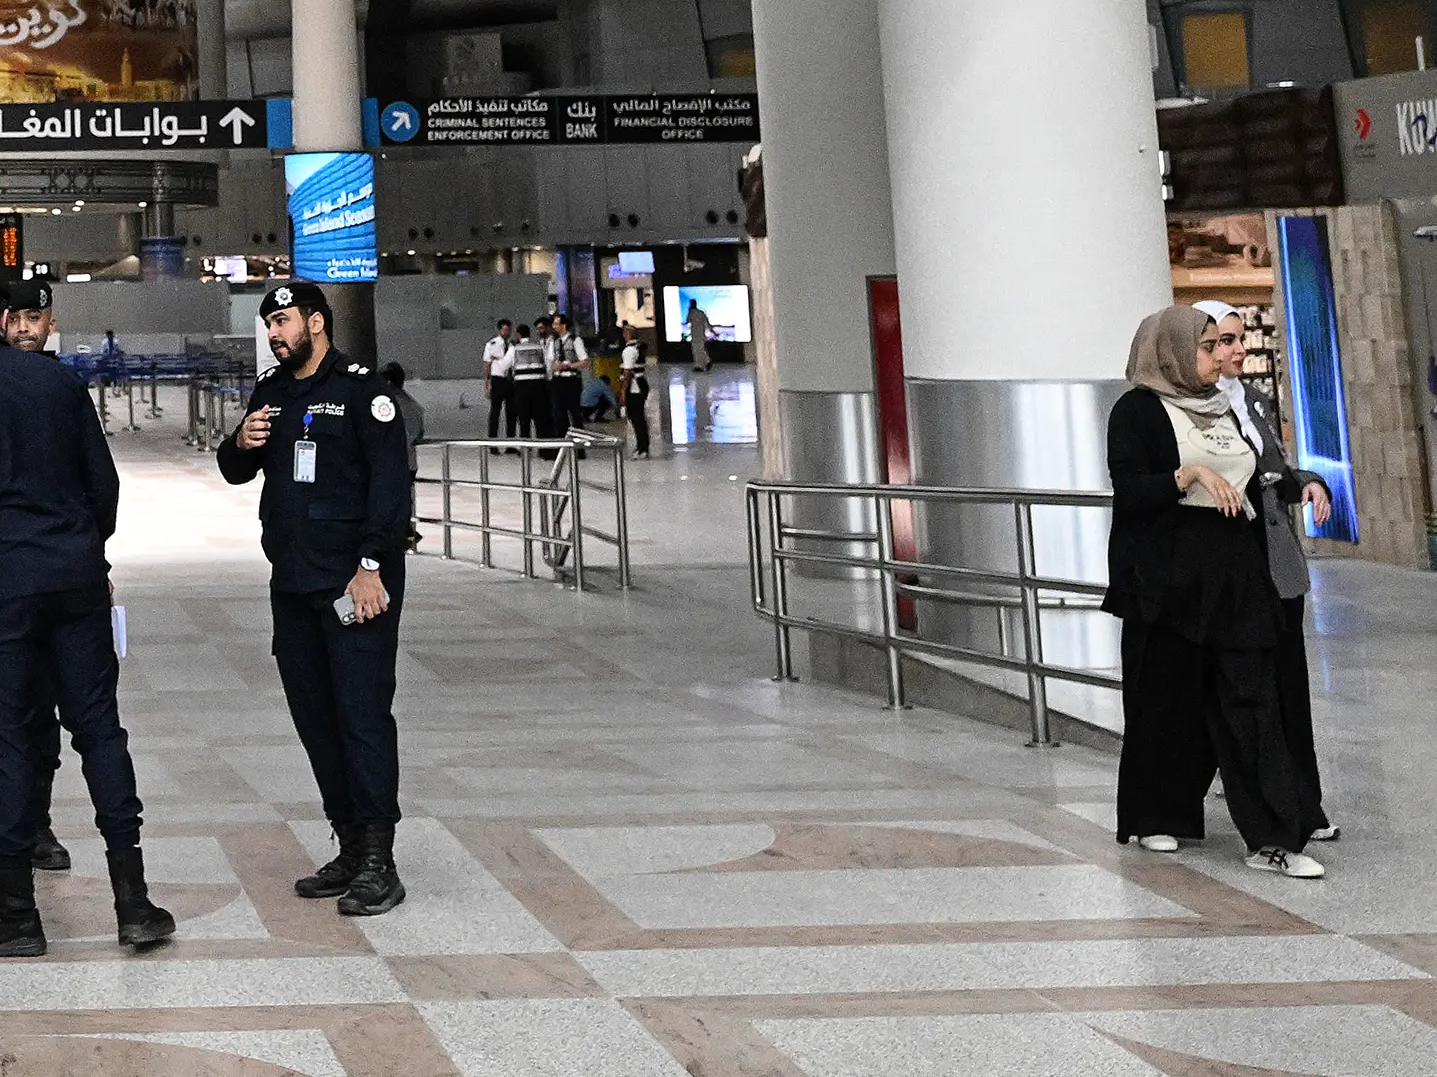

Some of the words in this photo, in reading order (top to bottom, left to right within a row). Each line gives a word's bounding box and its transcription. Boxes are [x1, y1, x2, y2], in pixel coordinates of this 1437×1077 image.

[474, 99, 509, 116] تنفيذ
[510, 99, 549, 115] مكاتب
[567, 100, 597, 122] بنك
[715, 97, 752, 114] مكتب
[88, 107, 209, 146] بوابات
[427, 118, 479, 128] CRIMINAL
[482, 117, 546, 128] SENTENCES
[614, 117, 676, 128] FINANCIAL
[678, 116, 754, 127] DISCLOSURE
[427, 130, 509, 141] ENFORCEMENT
[511, 129, 551, 140] OFFICE
[565, 122, 598, 139] BANK
[662, 128, 704, 140] OFFICE
